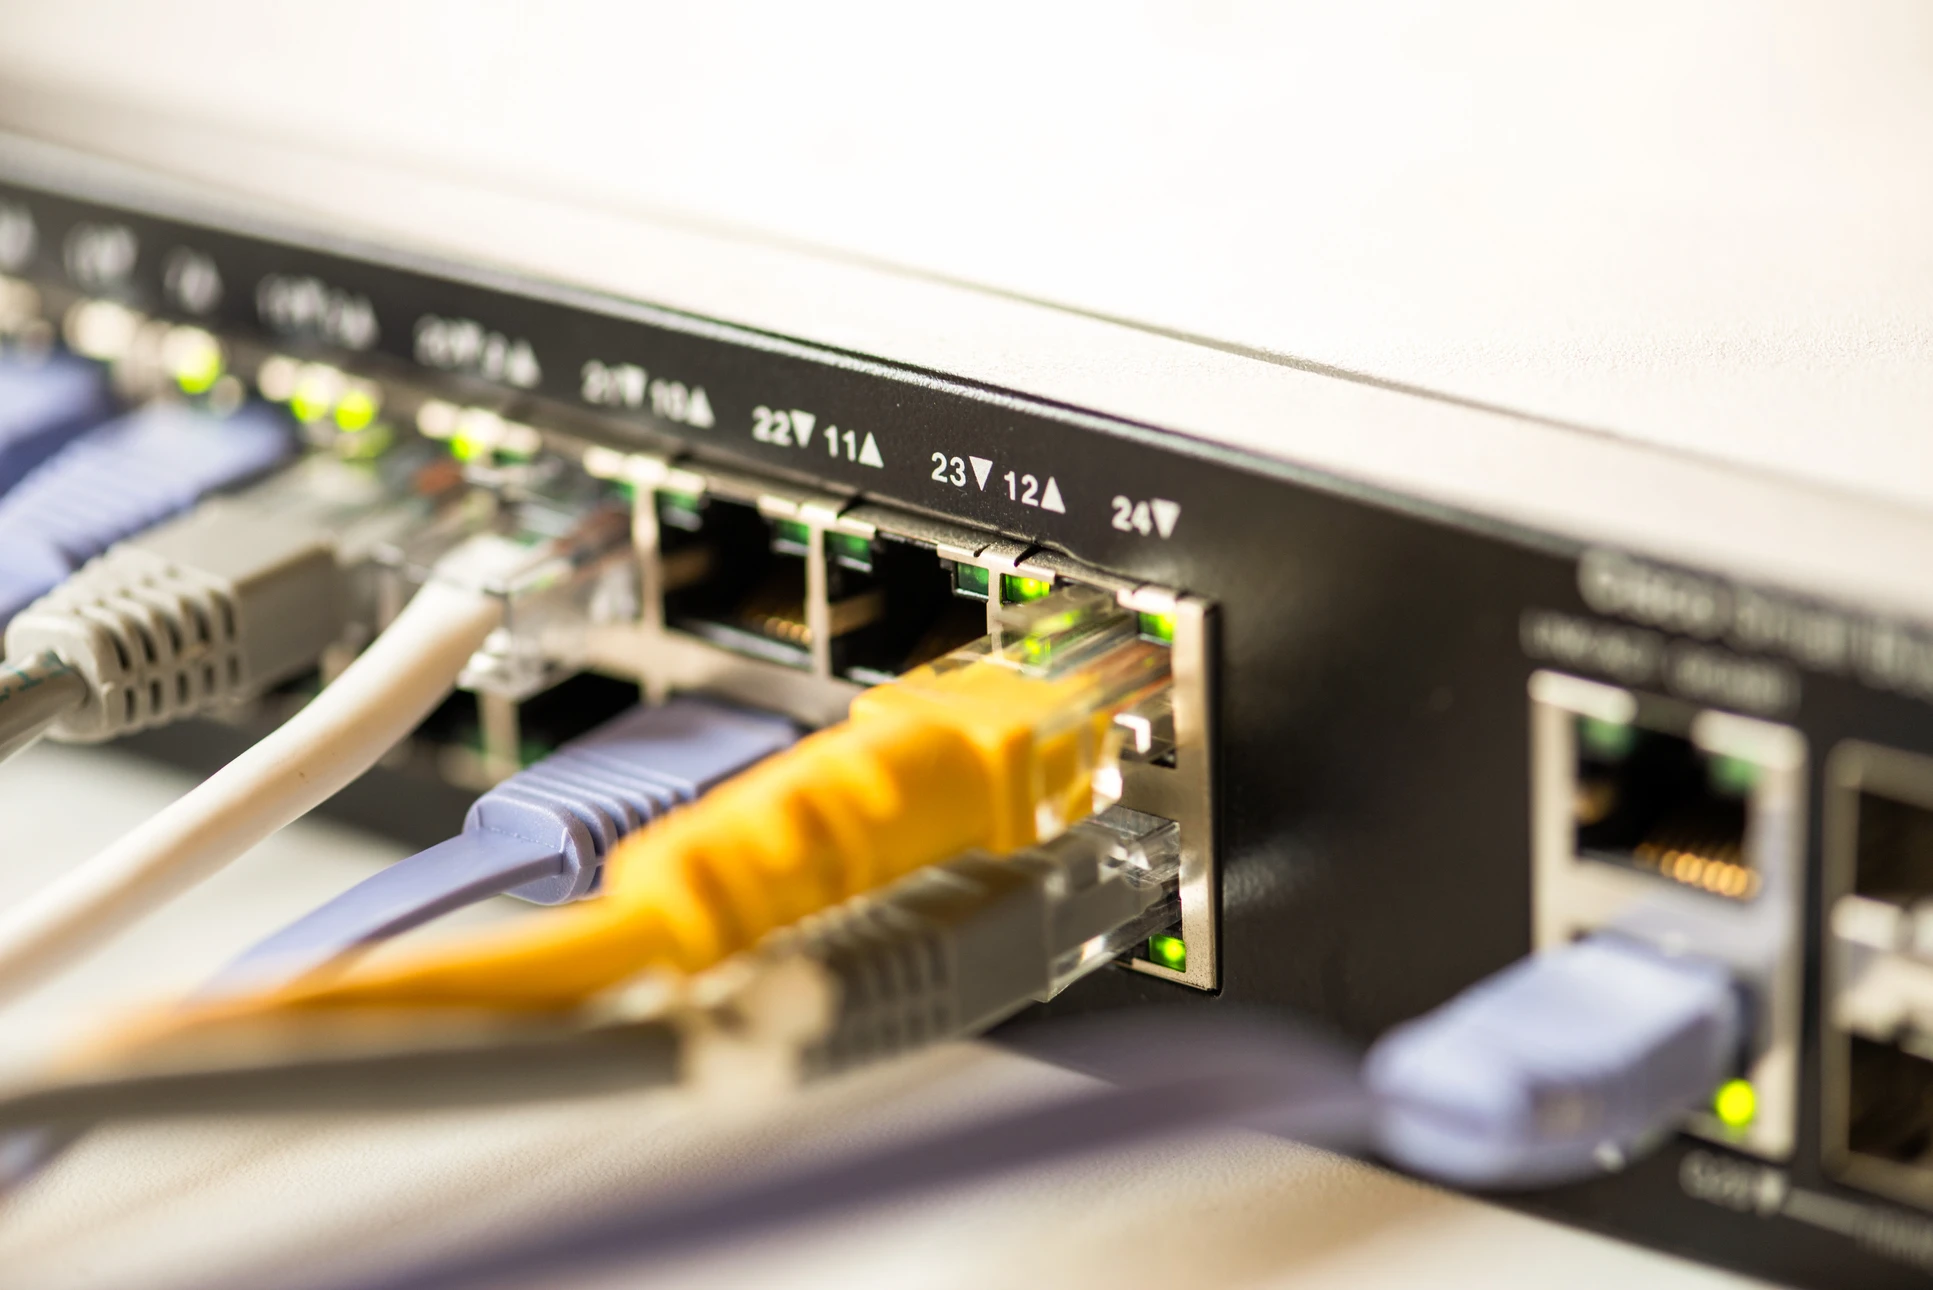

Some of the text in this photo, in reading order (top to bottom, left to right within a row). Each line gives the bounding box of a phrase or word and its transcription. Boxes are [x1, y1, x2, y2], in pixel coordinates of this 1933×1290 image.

[752, 405, 792, 446] 22
[824, 425, 857, 461] 11
[931, 452, 966, 487] 23
[1004, 471, 1039, 506] 12
[1111, 495, 1152, 536] 24
